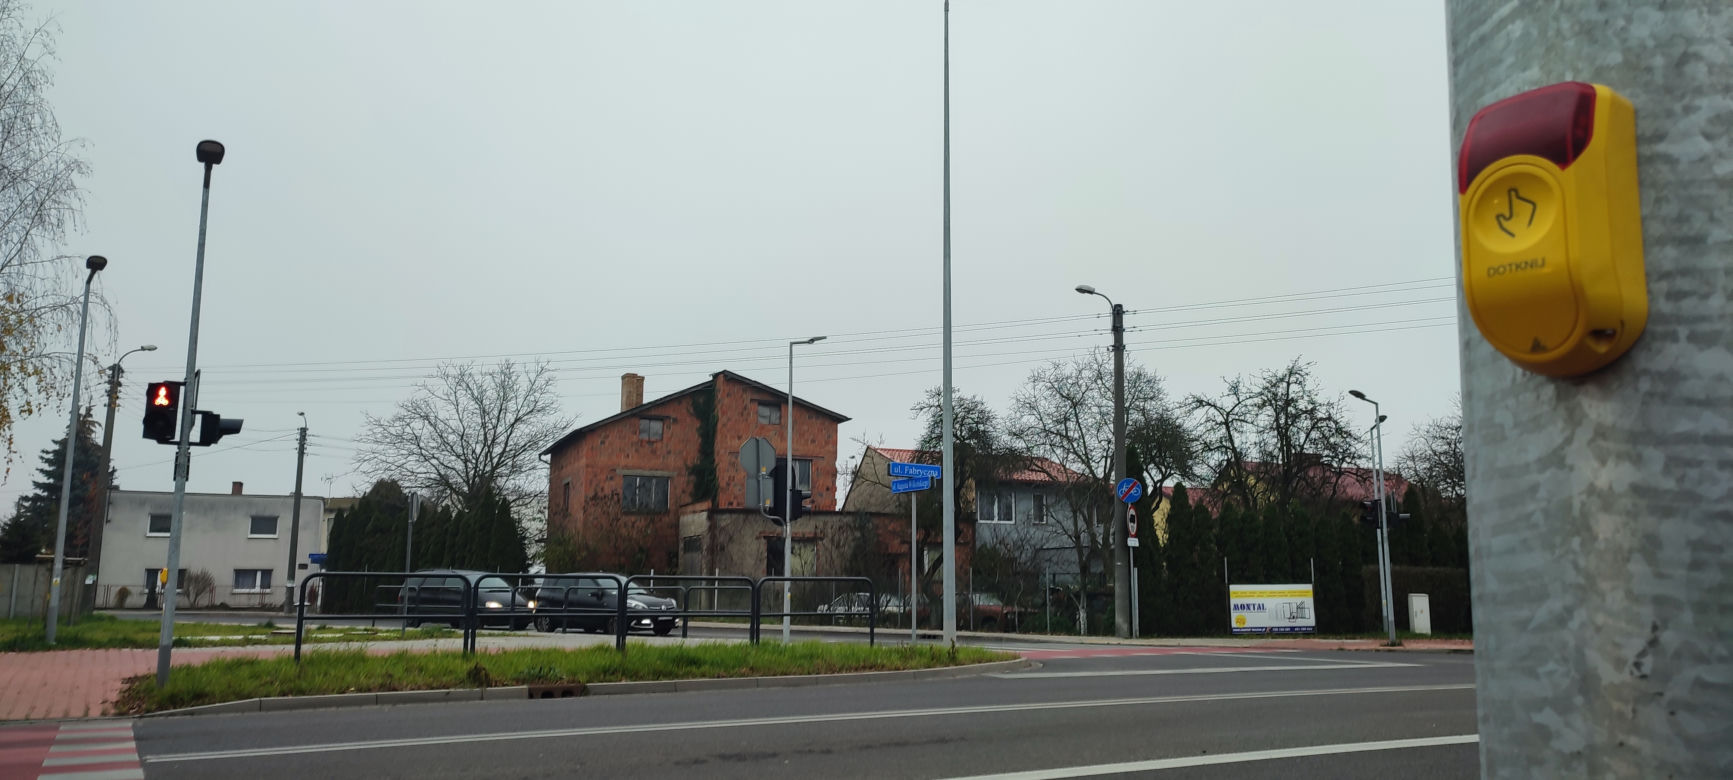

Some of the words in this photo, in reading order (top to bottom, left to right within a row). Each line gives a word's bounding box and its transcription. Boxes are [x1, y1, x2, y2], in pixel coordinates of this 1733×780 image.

[1487, 256, 1546, 278] DOTKNIJ
[894, 465, 903, 474] ul.
[904, 466, 938, 477] Fabryczna
